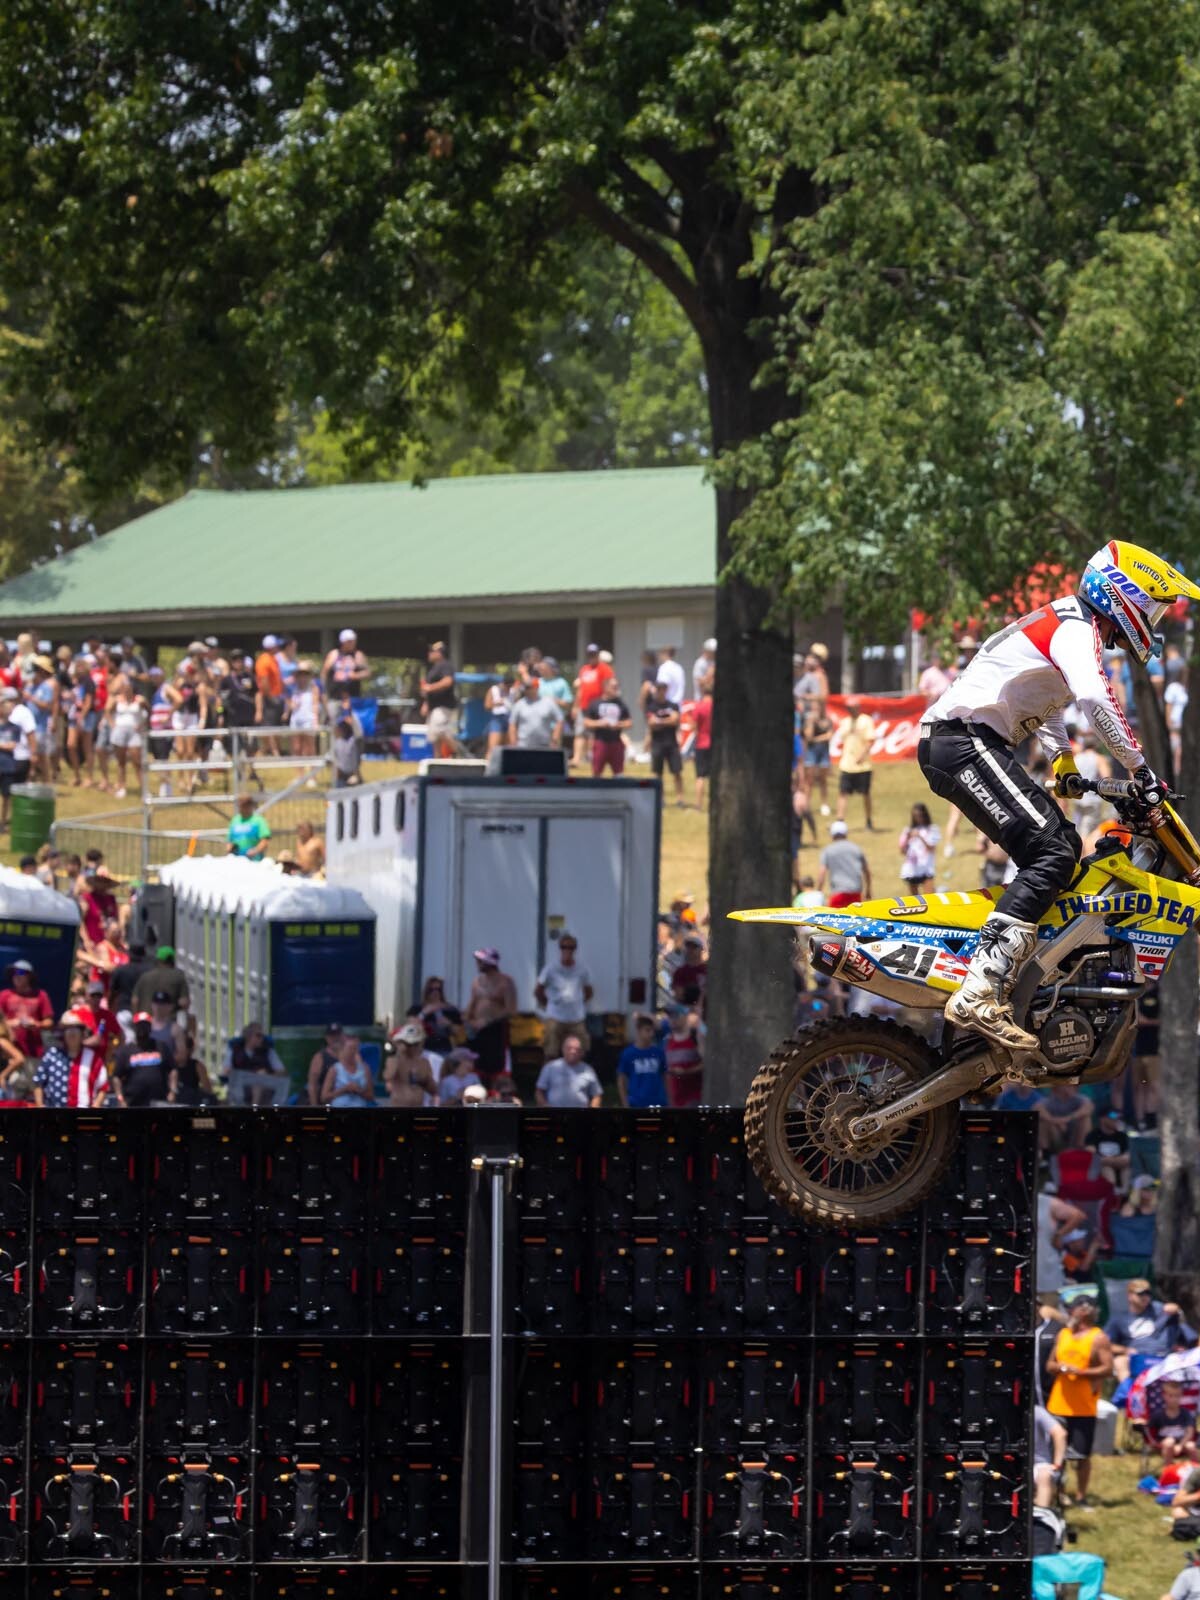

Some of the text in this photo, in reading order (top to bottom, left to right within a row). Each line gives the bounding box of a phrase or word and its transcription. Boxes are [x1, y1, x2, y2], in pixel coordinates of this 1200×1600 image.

[1133, 560, 1160, 581] TWISTED
[1158, 576, 1170, 593] TEA
[1102, 581, 1124, 608] THOR
[1117, 612, 1145, 653] PROGRESSIVE
[1092, 704, 1124, 745] TWISTED
[959, 769, 1011, 825] SUZUKI
[889, 905, 927, 915] GUTS
[1055, 891, 1196, 928] TWISTED TEA
[1127, 931, 1175, 945] SUZUKI
[1138, 946, 1167, 956] THOR
[878, 944, 939, 979] 41
[1049, 1034, 1090, 1048] SUZUKI
[885, 1101, 919, 1121] MAYHEM
